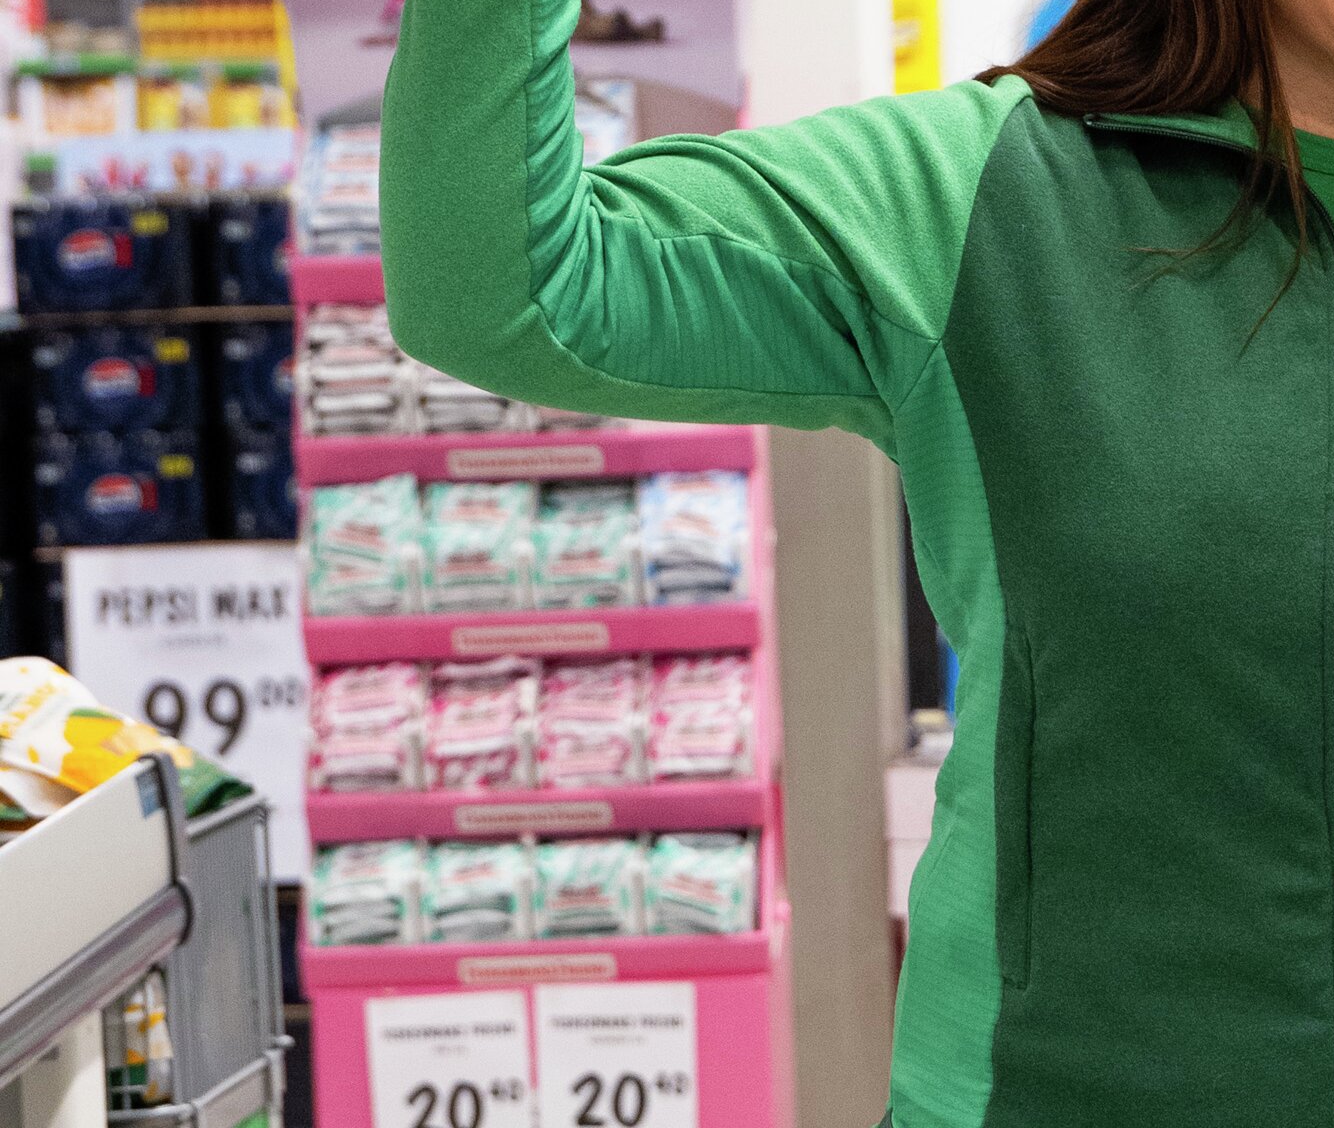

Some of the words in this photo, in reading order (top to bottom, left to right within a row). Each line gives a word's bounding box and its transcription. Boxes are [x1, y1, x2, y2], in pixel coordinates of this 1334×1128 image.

[97, 586, 197, 625] PEPSI
[211, 583, 286, 620] MAX
[406, 1080, 483, 1128] 20
[571, 1073, 649, 1128] 20
